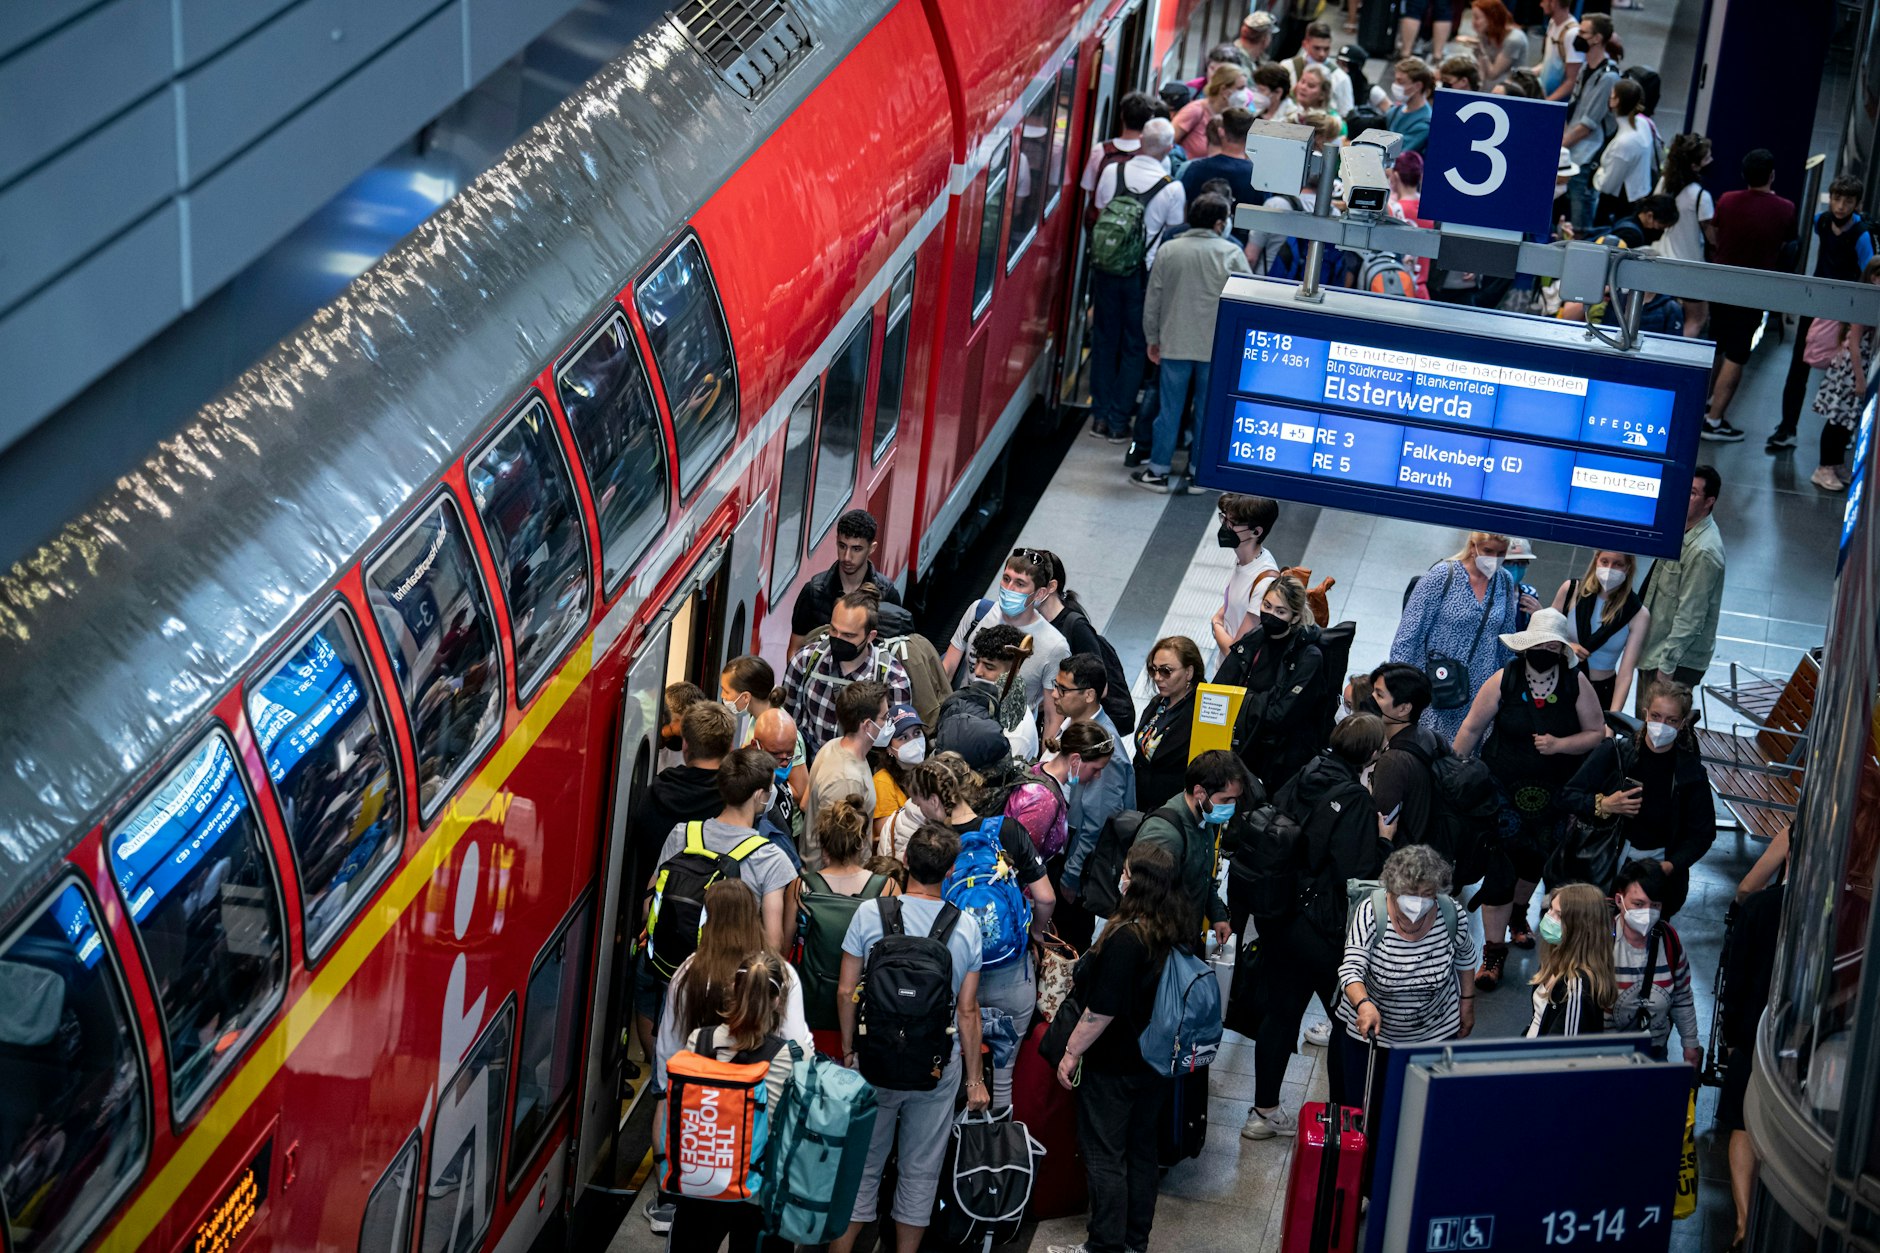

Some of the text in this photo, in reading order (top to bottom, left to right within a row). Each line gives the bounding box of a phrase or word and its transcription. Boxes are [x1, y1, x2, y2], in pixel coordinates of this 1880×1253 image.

[1443, 100, 1510, 197] 3
[1243, 348, 1310, 368] RE 5 / 4361
[1248, 330, 1293, 351] 15:18
[1326, 360, 1345, 374] Bln
[1348, 363, 1404, 383] Südkreuz
[1415, 373, 1495, 396] Blankenfelde
[1363, 349, 1414, 366] nutzen
[1420, 357, 1441, 370] Sie
[1446, 361, 1468, 374] die
[1472, 366, 1583, 391] nachfolgenden
[1324, 375, 1473, 419] Elsterwerda
[1235, 417, 1523, 473] 15:34 +5 RE 3 Falkenberg (E)
[1600, 417, 1608, 427] F
[1611, 419, 1619, 429] E
[1623, 421, 1631, 430] D
[1635, 423, 1642, 431] C
[1647, 424, 1654, 433] B
[1657, 426, 1666, 435] A
[1231, 441, 1453, 488] 16:18 RE 5 Baruth
[1603, 476, 1655, 492] nutzen
[680, 1108, 700, 1164] FACE
[697, 1088, 720, 1167] NORTH
[715, 1125, 735, 1167] THE
[1542, 1207, 1625, 1245] 13-14
